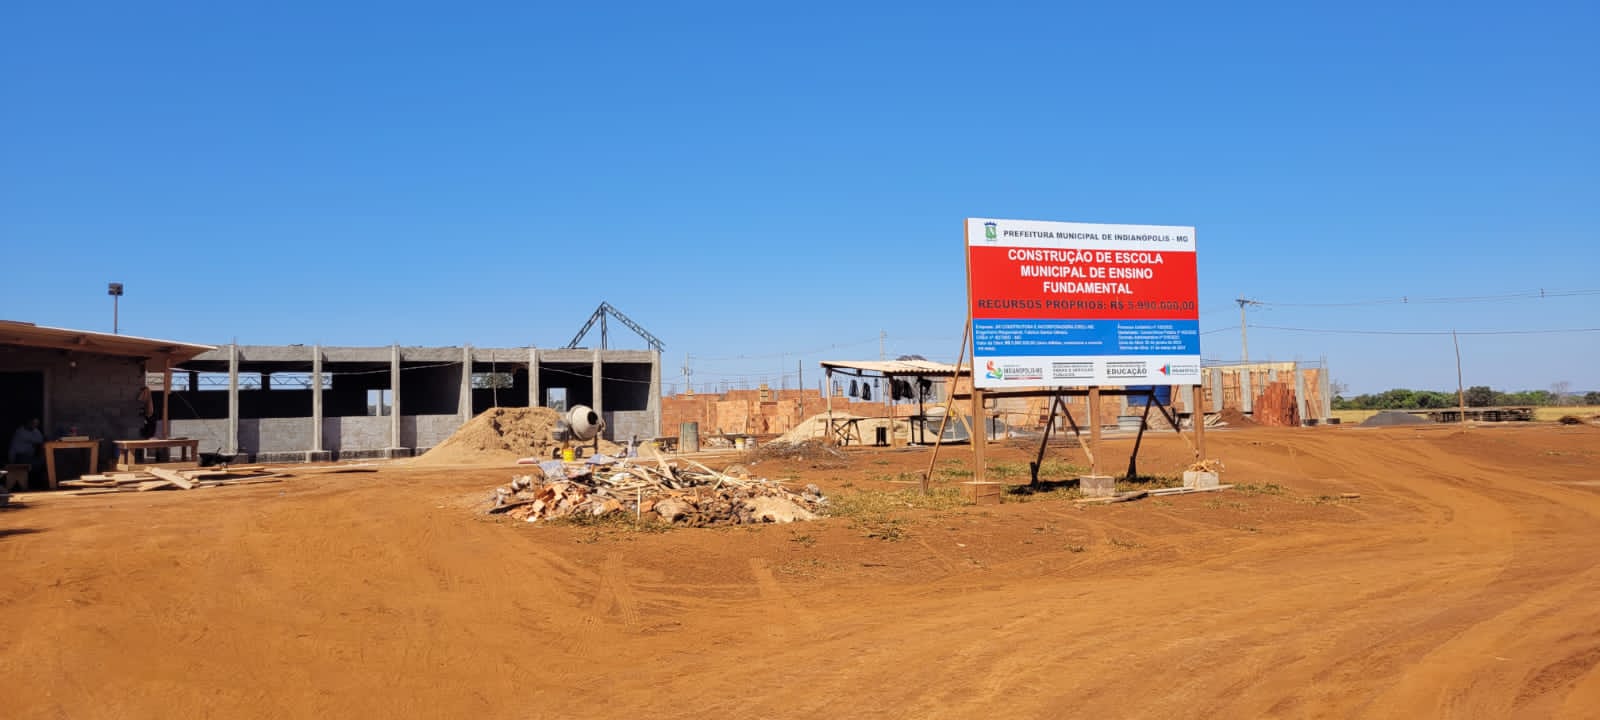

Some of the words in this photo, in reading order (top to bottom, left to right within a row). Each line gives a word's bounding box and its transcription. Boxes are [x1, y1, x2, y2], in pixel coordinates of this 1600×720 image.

[1003, 230, 1054, 239] PREFEITURA
[1056, 232, 1100, 240] MUNICIPAL
[1101, 233, 1113, 241] DE
[1176, 235, 1189, 243] MG
[1008, 249, 1093, 264] CONSTRUÇÃO
[1095, 251, 1113, 263] DE
[1115, 252, 1164, 264] ESCOLA
[1020, 265, 1087, 278] MUNICIPAL
[1089, 267, 1106, 278] DE
[1109, 267, 1153, 279] ENSINO
[1043, 281, 1133, 294] FUNDAMENTAL
[978, 299, 1042, 309] RECURSOS
[1110, 301, 1124, 310] R$
[1127, 301, 1195, 311] 5.990.000,00
[1106, 366, 1148, 377] EDUCAÇÃO
